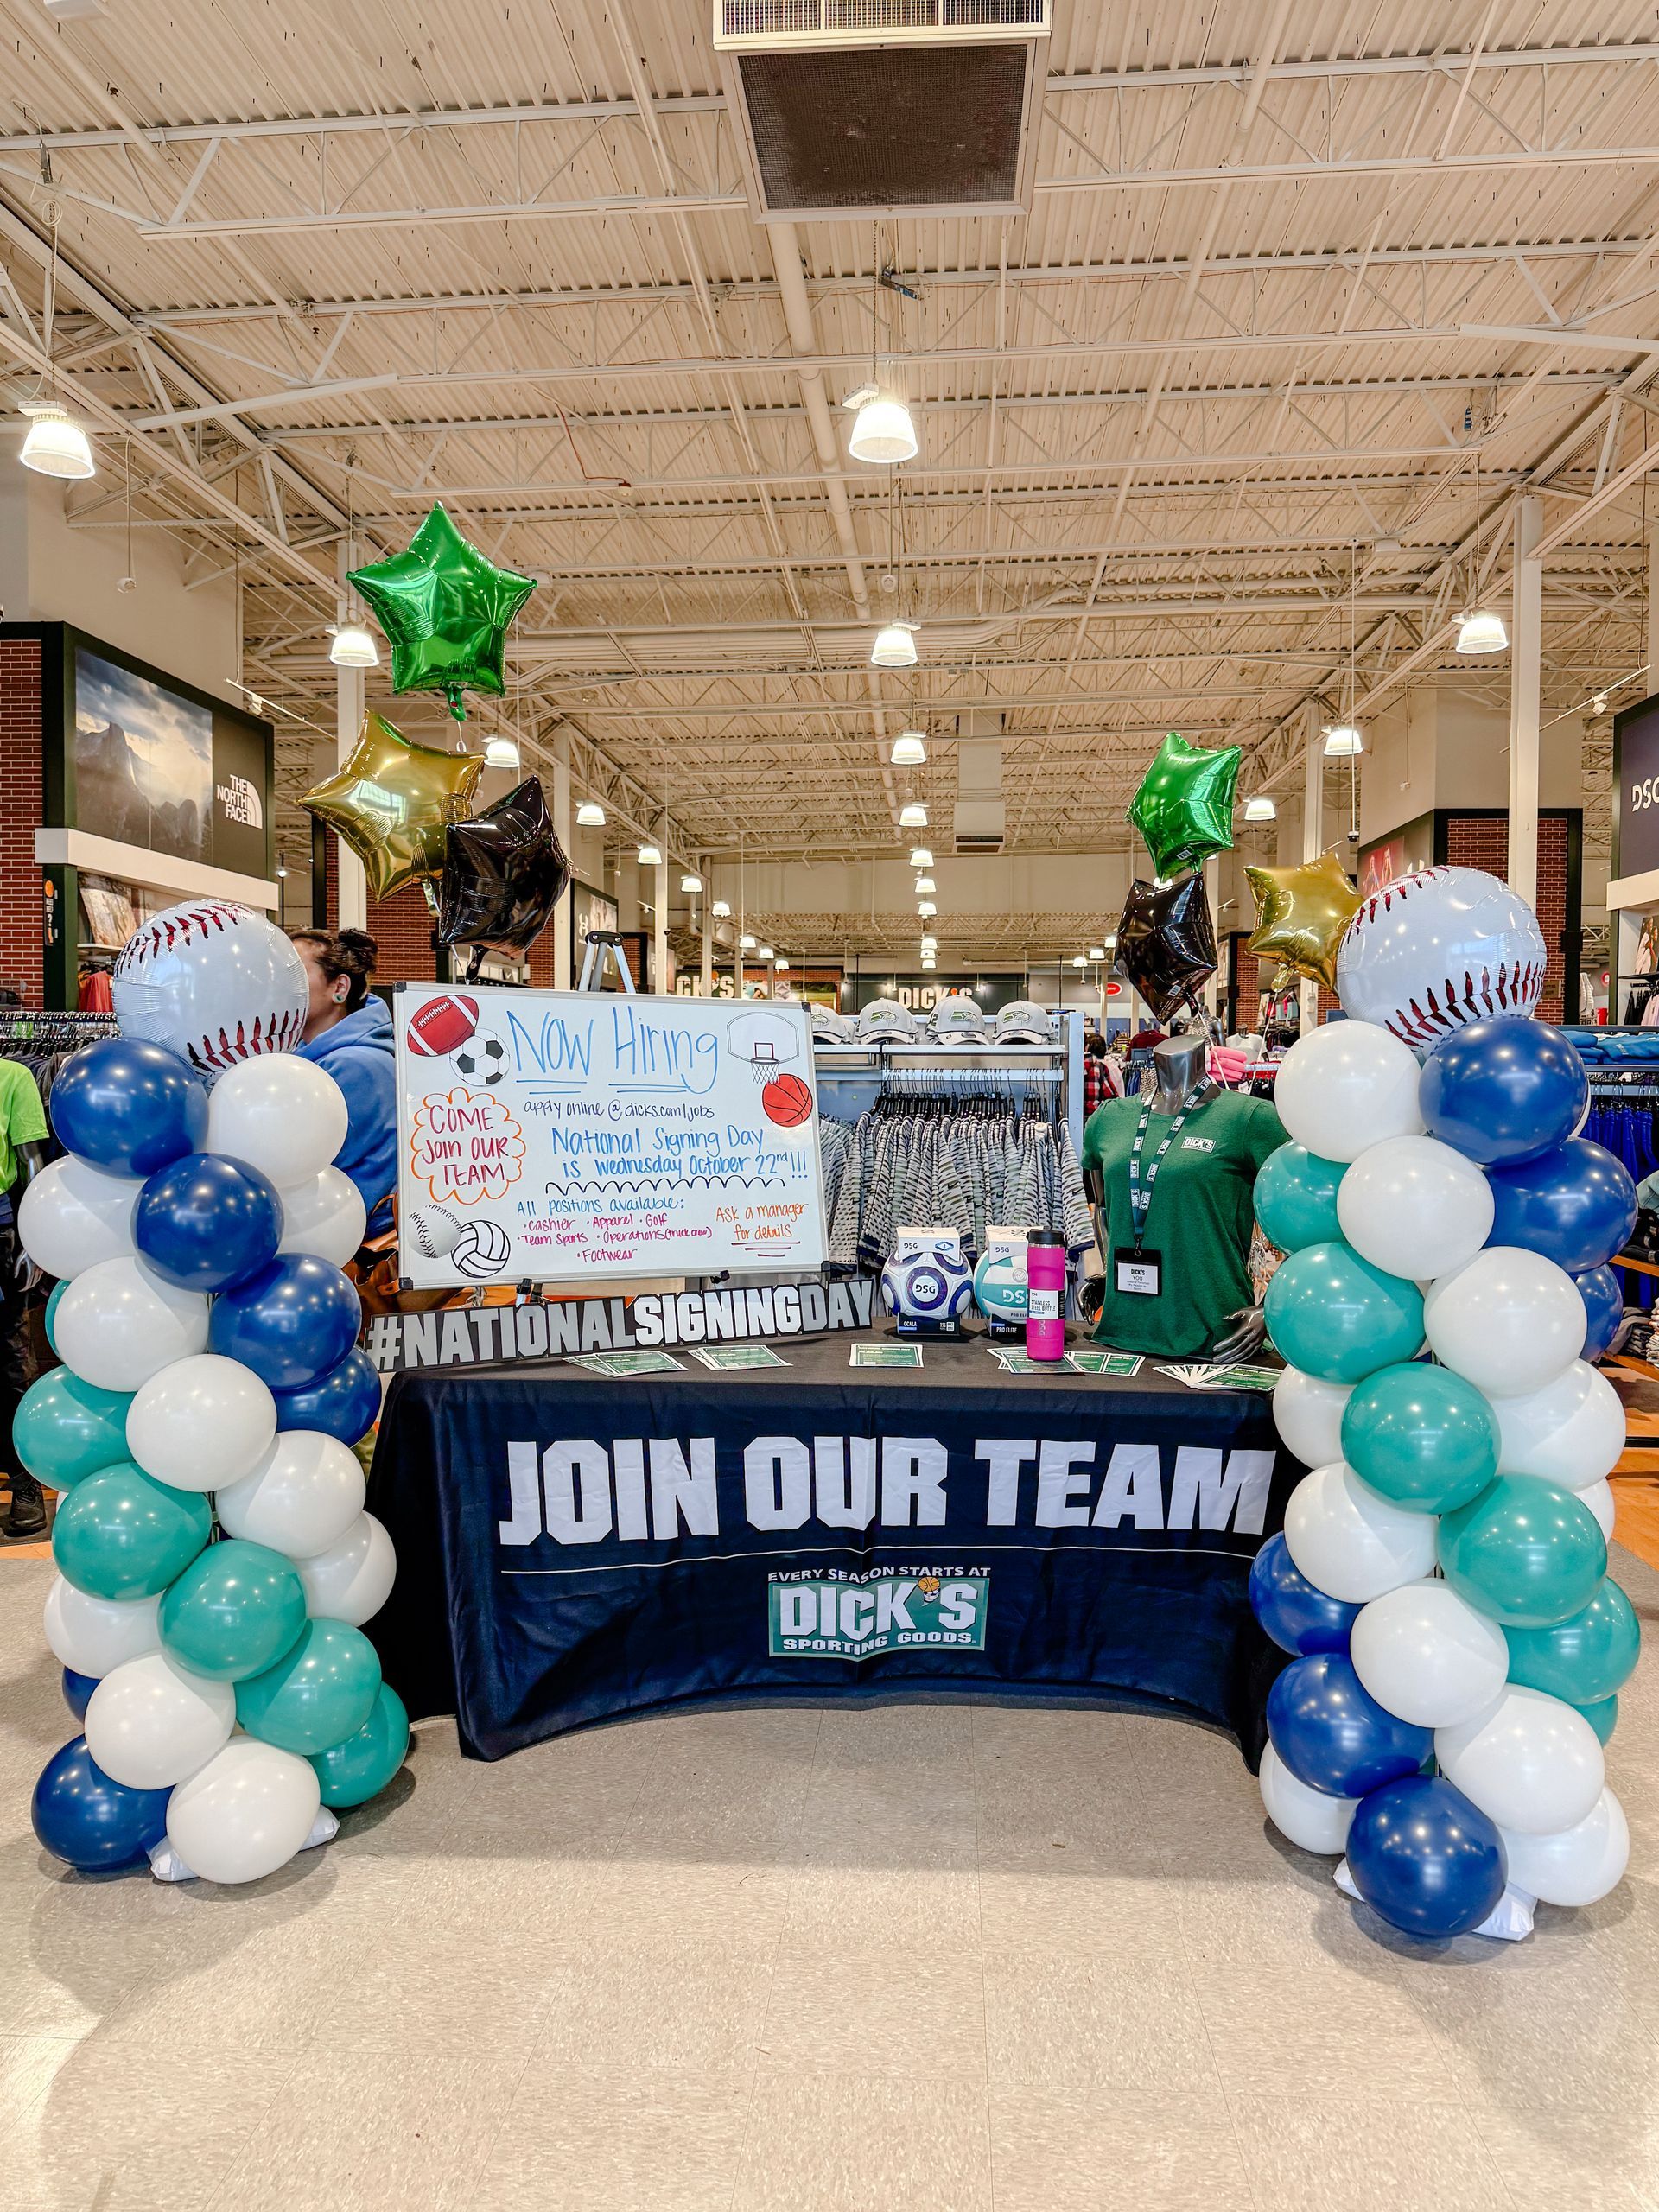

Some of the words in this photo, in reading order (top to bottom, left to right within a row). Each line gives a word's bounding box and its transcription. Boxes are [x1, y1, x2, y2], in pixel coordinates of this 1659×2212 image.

[229, 774, 247, 795] THE
[217, 785, 247, 810] NORTH
[226, 803, 247, 824] FACE
[613, 1006, 718, 1095] Hiring
[429, 1105, 494, 1134] COME
[524, 1099, 561, 1119] apply
[566, 1102, 605, 1116] online
[607, 1099, 622, 1122] @
[551, 1127, 641, 1156] National
[652, 1127, 721, 1158] Signing
[727, 1124, 764, 1154] Day
[1184, 1138, 1215, 1151] DICK'S
[441, 1162, 505, 1186] TEAM
[563, 1160, 582, 1179] is
[690, 1154, 751, 1176] October
[518, 1200, 537, 1217] All
[715, 1205, 740, 1223] Ask
[745, 1206, 754, 1220] a
[756, 1202, 810, 1223] manager
[593, 1213, 633, 1230] Apparel
[645, 1212, 669, 1227] Golf
[521, 1234, 553, 1245] Team
[556, 1232, 589, 1247] Sports
[734, 1224, 753, 1241] for
[754, 1224, 792, 1241] details
[582, 1248, 638, 1263] Footwear
[915, 1284, 936, 1294] DSG
[1002, 1289, 1028, 1304] DS
[366, 1280, 874, 1370] #NATIONALSIGNINGDAY
[499, 1436, 720, 1547] JOIN
[742, 1434, 949, 1533] OUR
[973, 1438, 1276, 1536] TEAM
[767, 1568, 823, 1583] EVERY
[827, 1566, 896, 1585] SEASON
[898, 1566, 965, 1578] STARTS
[967, 1567, 992, 1577] AT
[779, 1581, 978, 1642] DICK'S
[782, 1635, 889, 1656] SPORTING
[897, 1631, 973, 1644] GOODS
